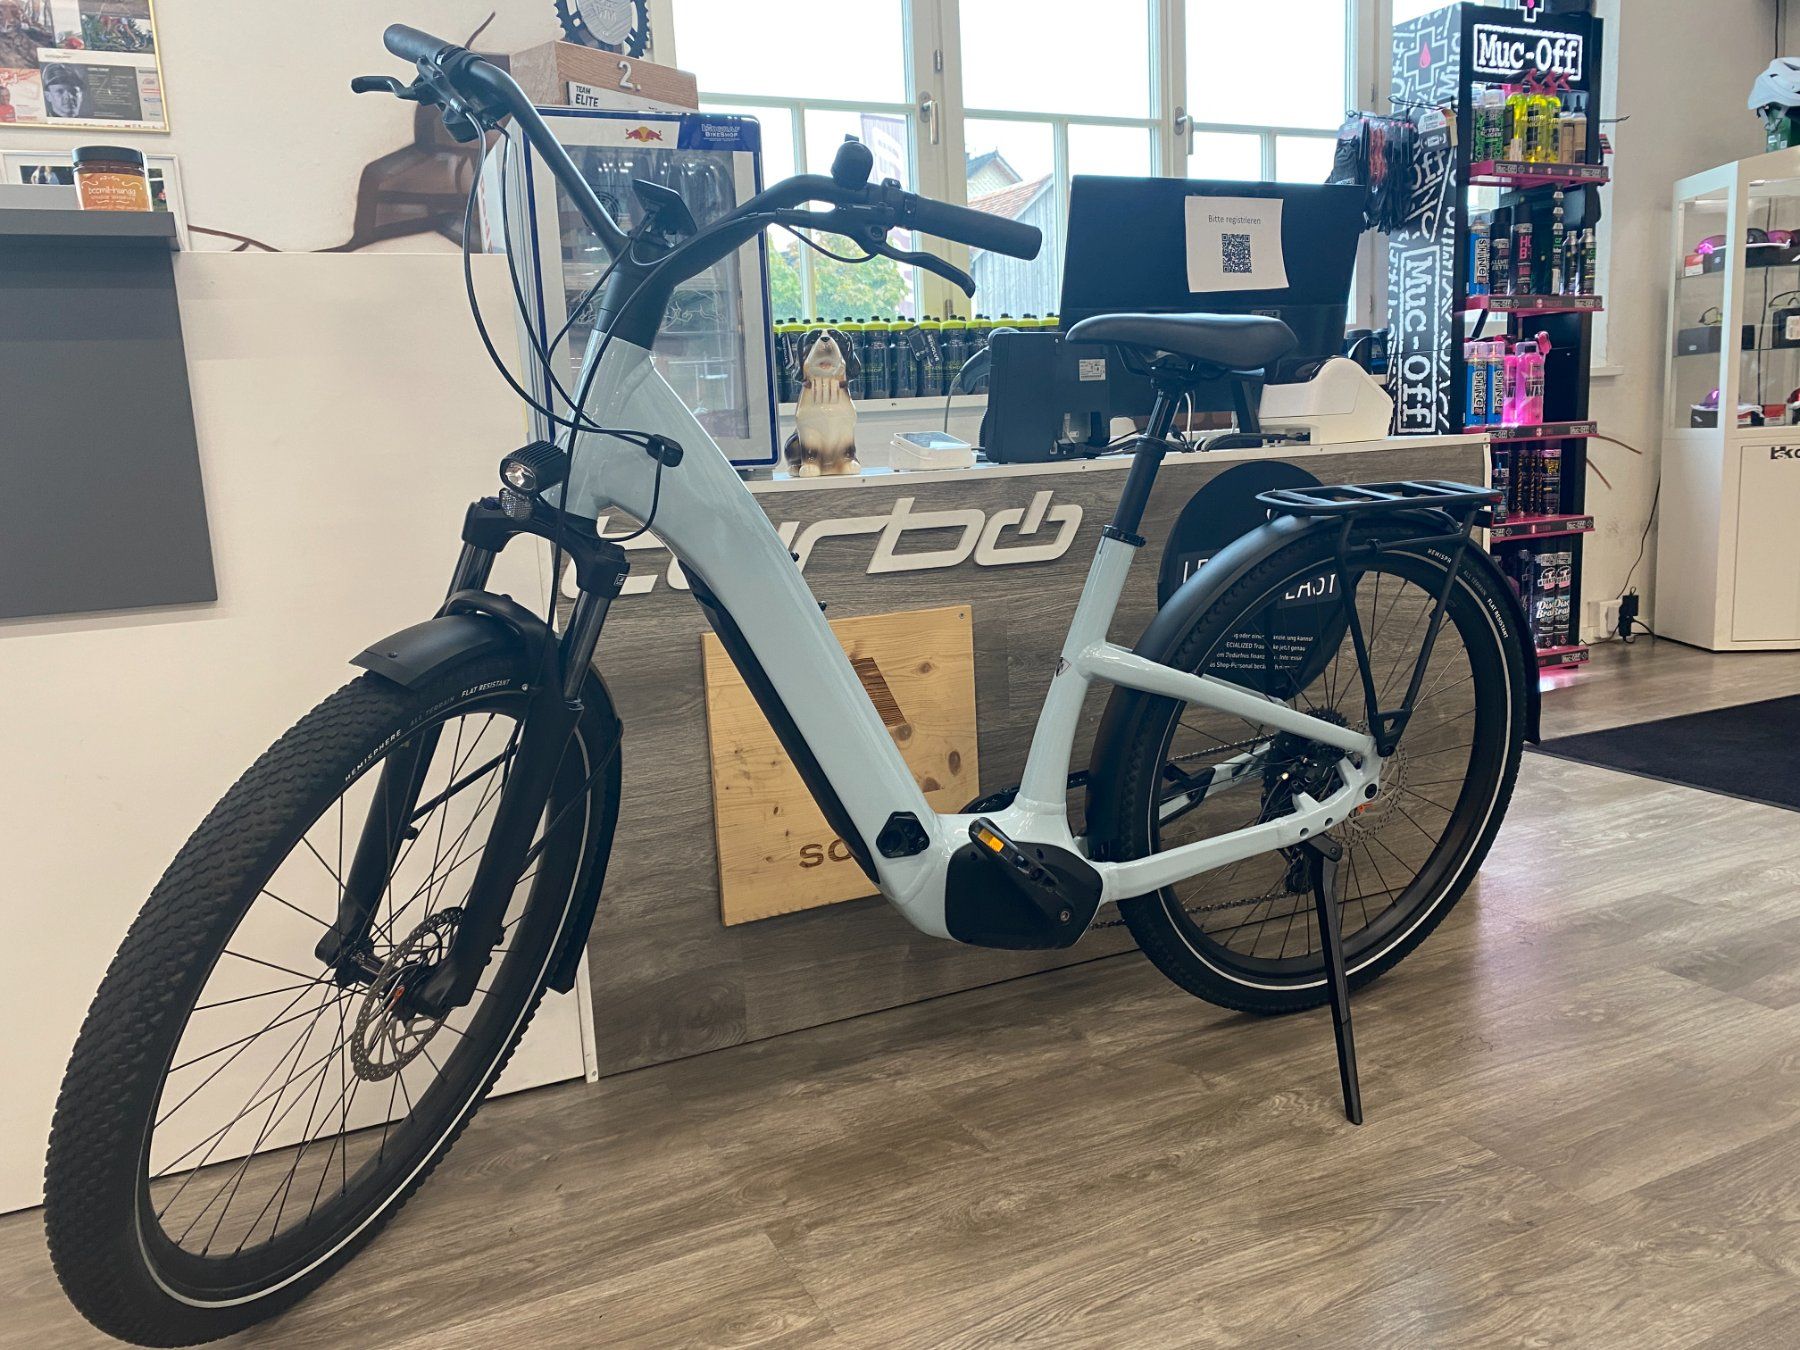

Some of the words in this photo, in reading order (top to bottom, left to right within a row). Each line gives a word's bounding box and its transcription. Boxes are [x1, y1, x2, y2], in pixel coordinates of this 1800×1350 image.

[1478, 32, 1578, 75] Muc-Off
[575, 85, 591, 95] TEAM
[575, 93, 599, 108] ELITE
[1208, 214, 1225, 223] Bitte
[1226, 216, 1262, 225] registrieren
[1403, 255, 1433, 423] Muc-Off
[1487, 598, 1497, 611] FLAT
[1493, 609, 1509, 639] RESISTANT
[344, 728, 402, 782] HEMISPHERE
[461, 686, 479, 698] FLAT
[479, 679, 511, 691] RESISTANT
